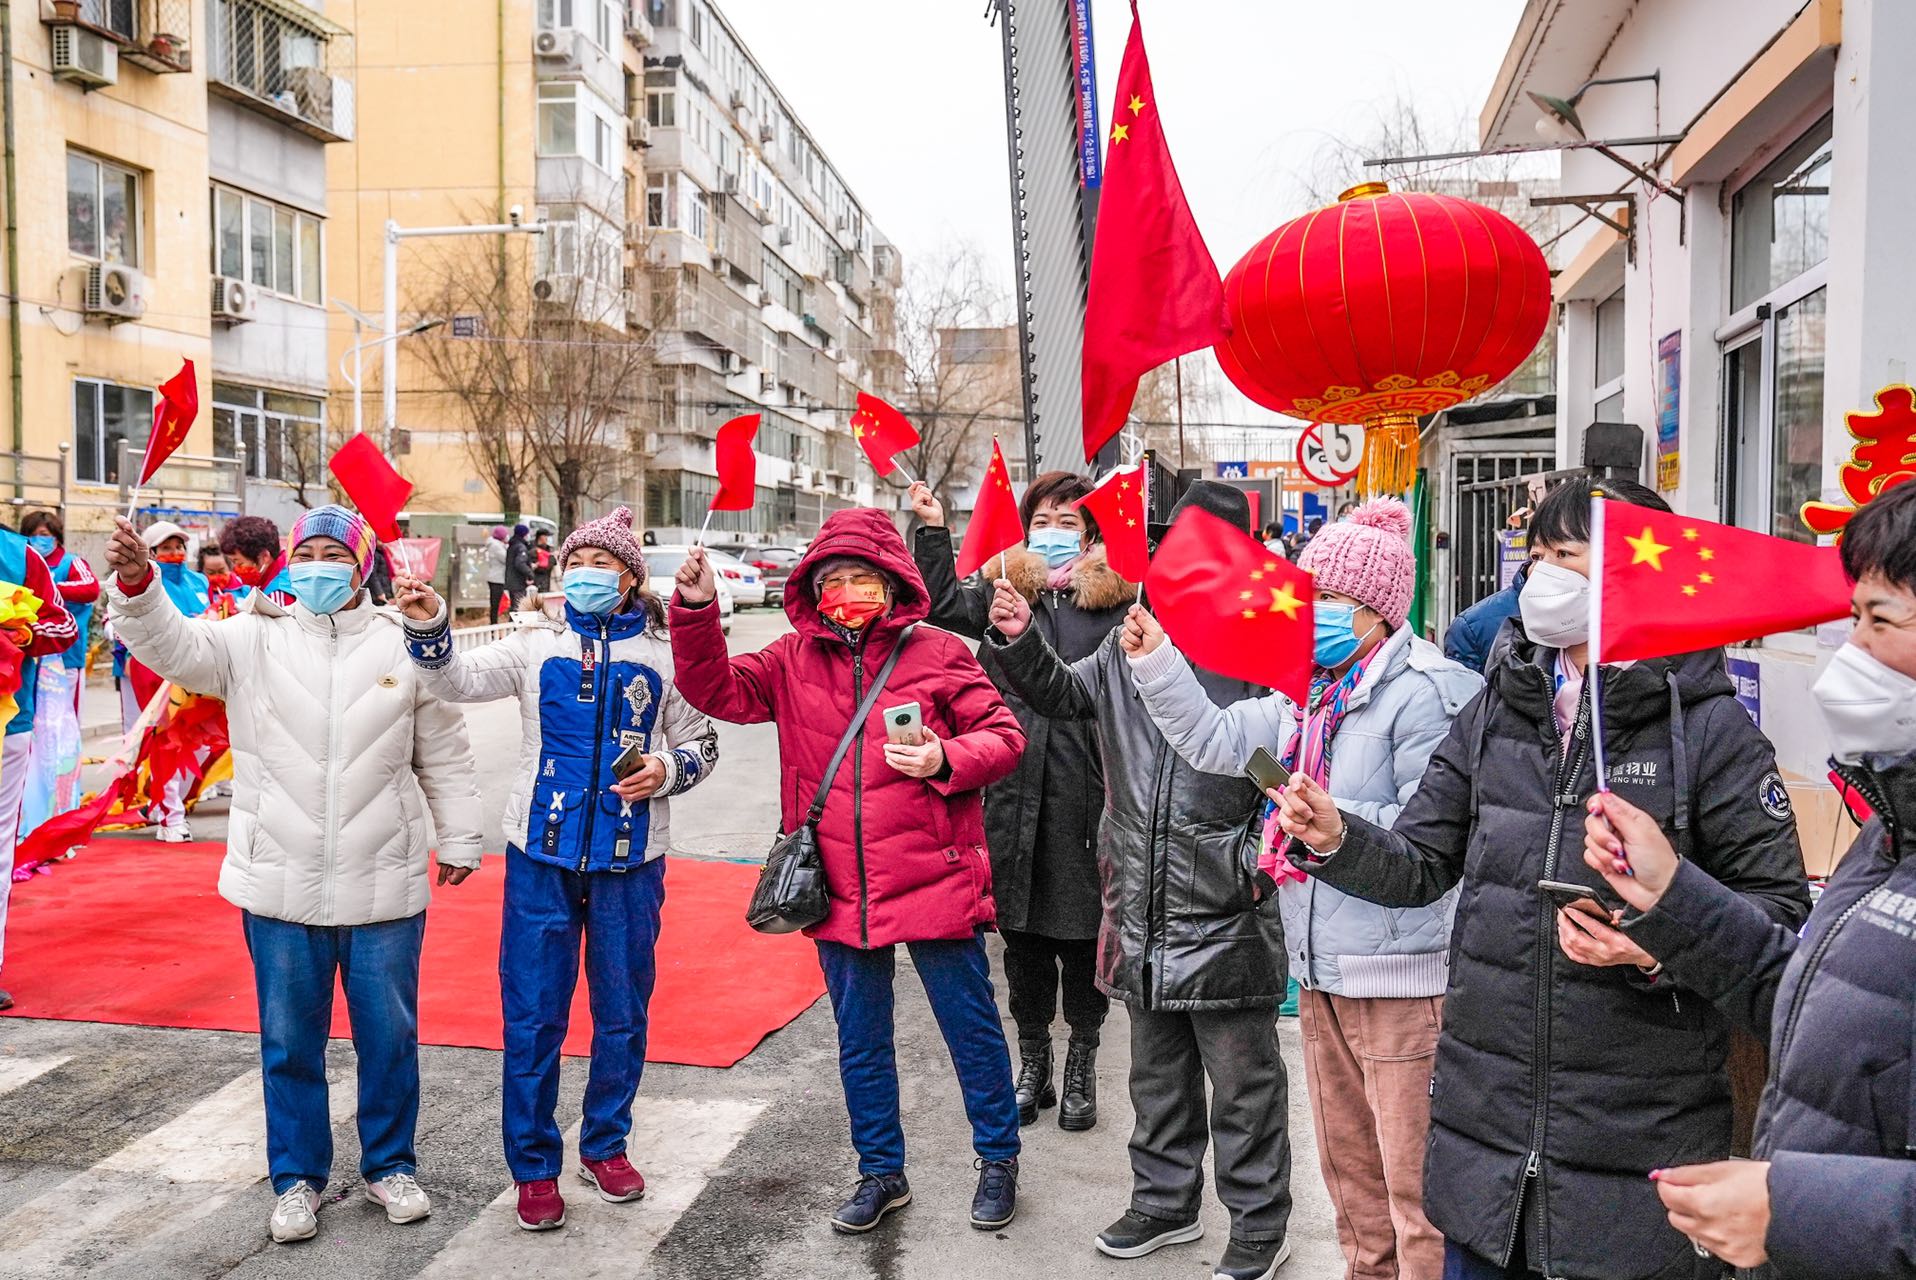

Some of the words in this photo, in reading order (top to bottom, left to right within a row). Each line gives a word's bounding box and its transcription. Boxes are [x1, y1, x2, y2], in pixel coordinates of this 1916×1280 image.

[1335, 424, 1352, 462] 5
[624, 734, 643, 742] ARCTIC
[1632, 777, 1644, 785] WU
[1646, 778, 1656, 786] YE
